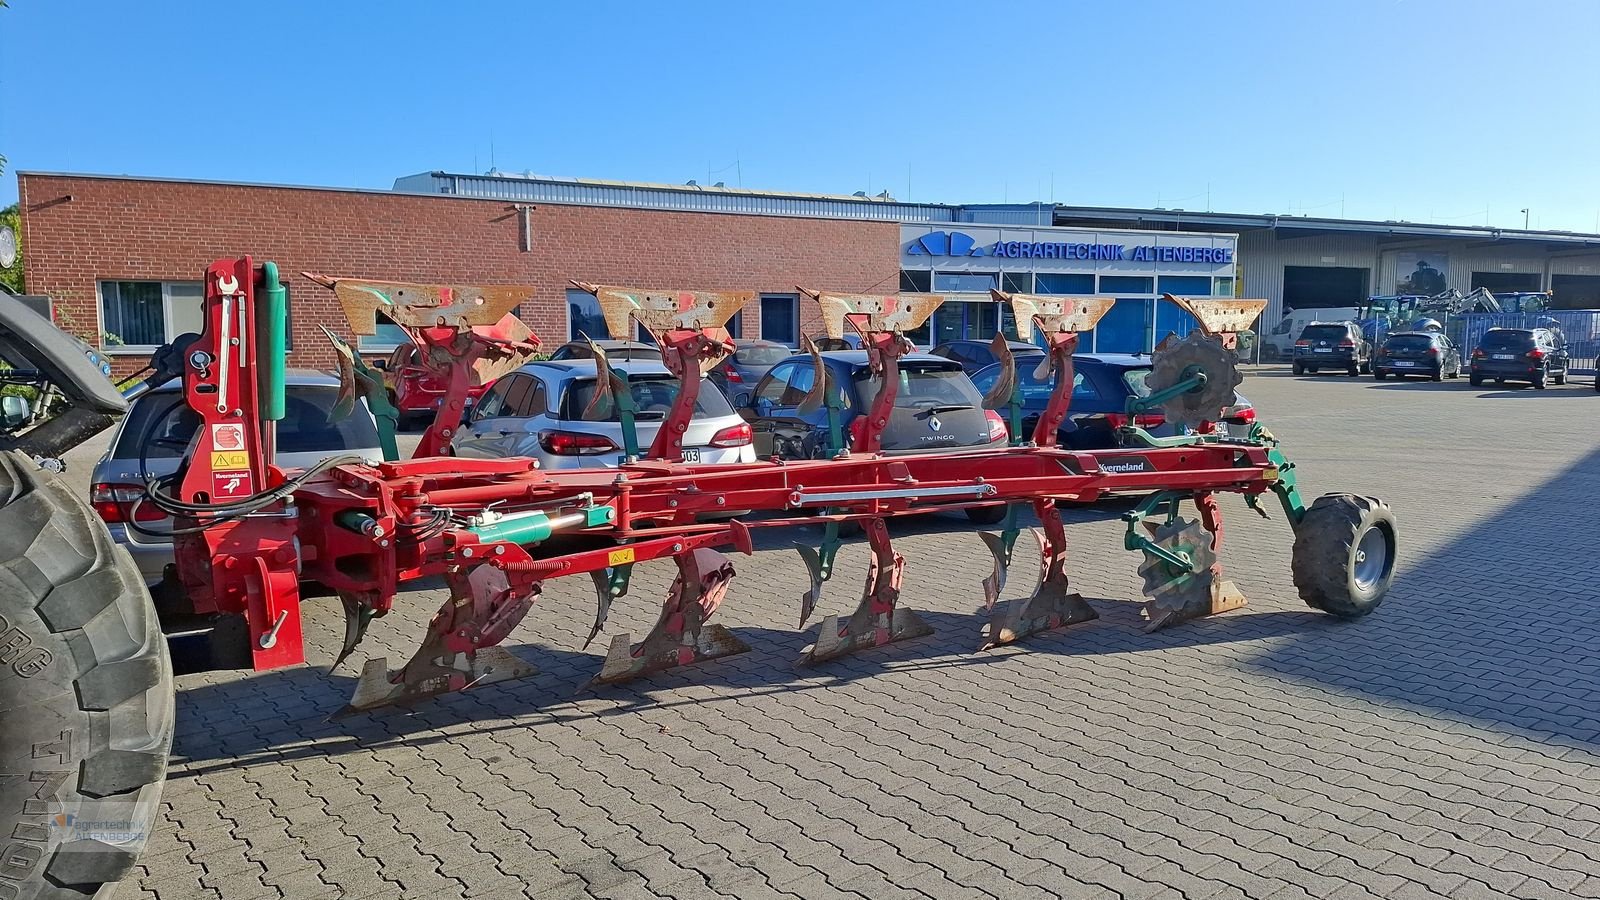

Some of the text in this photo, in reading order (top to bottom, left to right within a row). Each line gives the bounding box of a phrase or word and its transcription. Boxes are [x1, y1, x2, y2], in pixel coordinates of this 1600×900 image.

[993, 240, 1233, 263] AGRARTECHNIK ALTENBERGE
[1099, 462, 1144, 472] Kverneland
